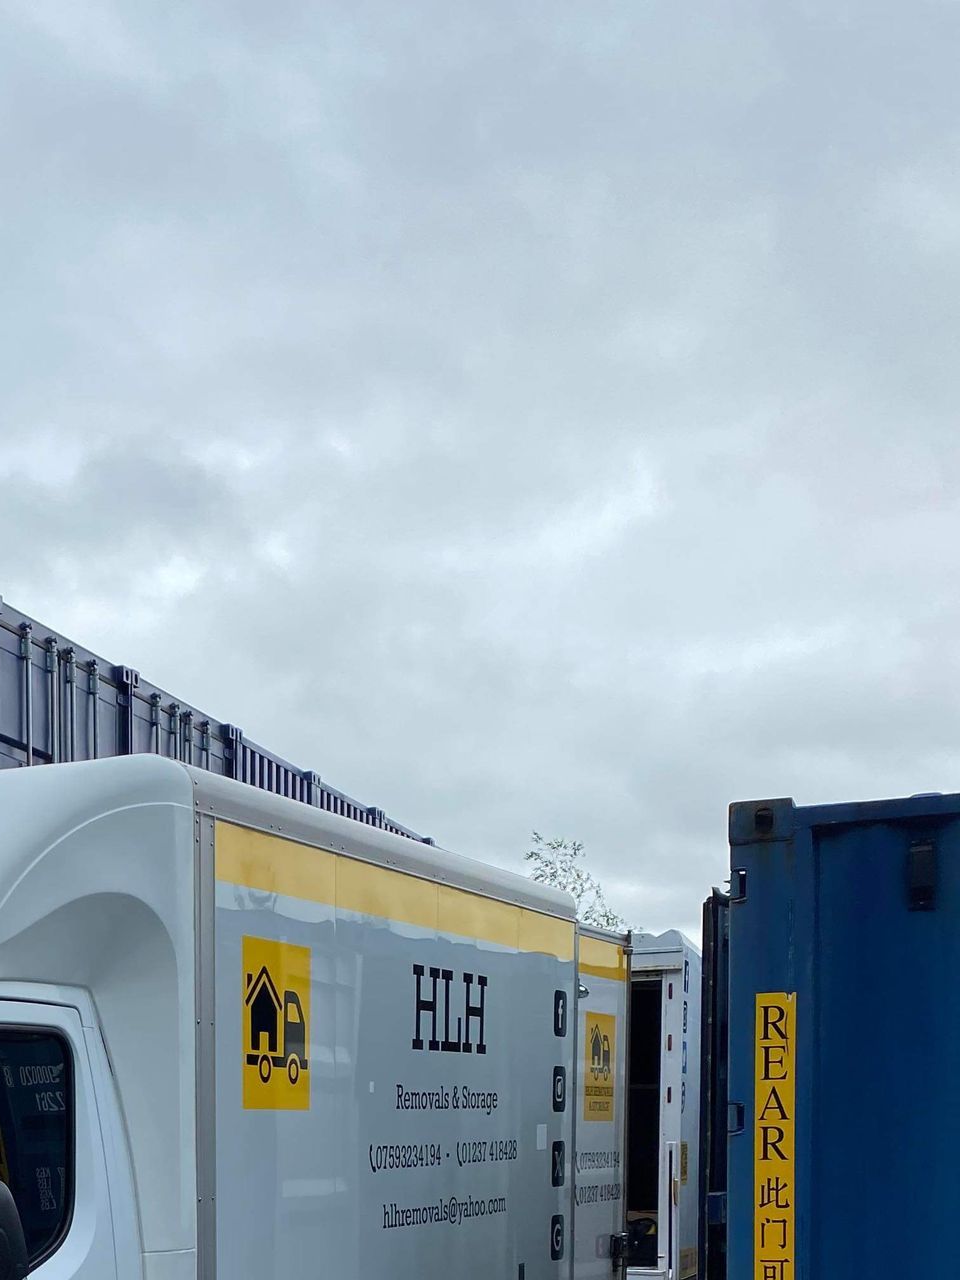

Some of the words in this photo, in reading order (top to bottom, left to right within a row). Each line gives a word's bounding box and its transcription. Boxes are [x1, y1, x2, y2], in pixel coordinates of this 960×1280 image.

[412, 964, 488, 1055] HLH
[396, 1084, 449, 1110] Removals
[452, 1085, 460, 1109] &
[462, 1085, 498, 1115] Storage
[759, 1005, 790, 1162] REAR
[375, 1144, 441, 1170] 07593234194
[462, 1141, 487, 1164] 01237
[489, 1139, 517, 1162] 418428
[382, 1195, 507, 1229] hlhremovals@yahoo.com
